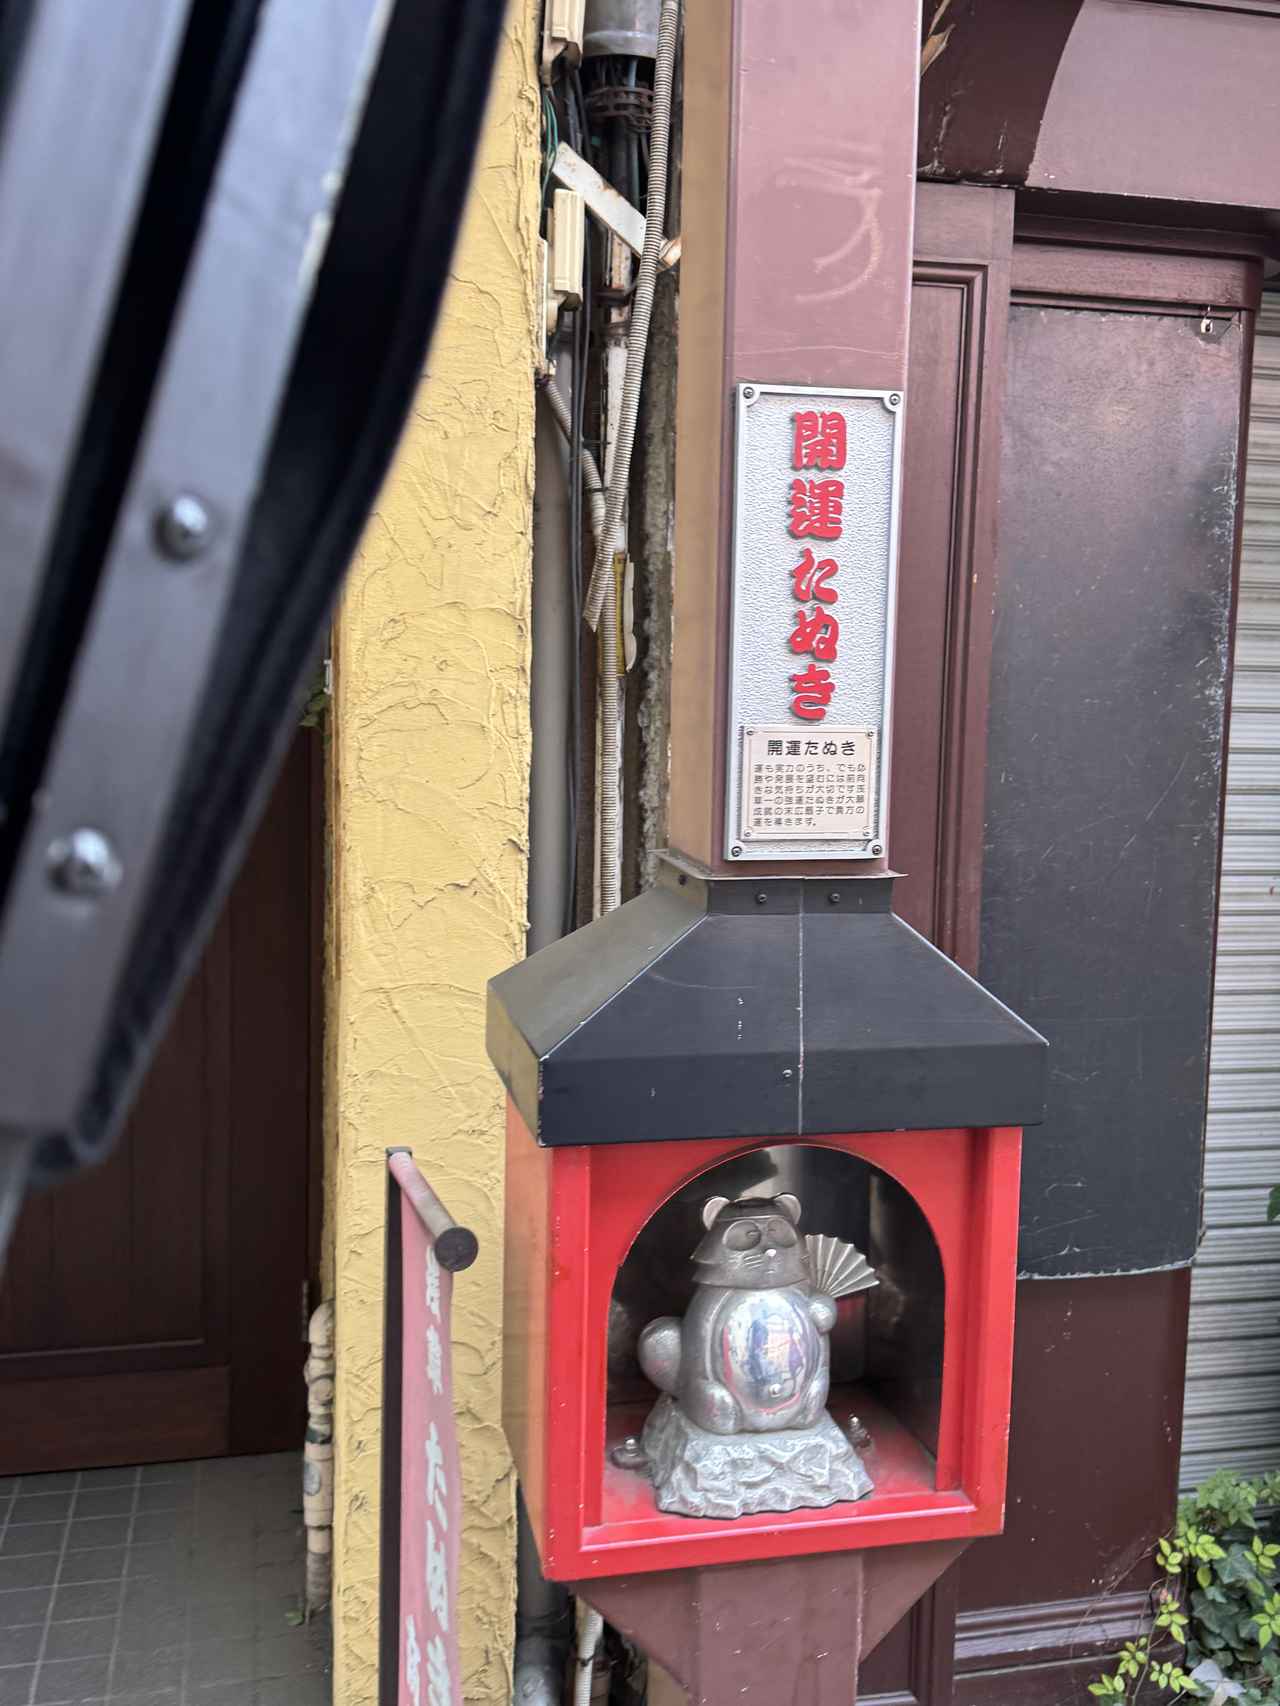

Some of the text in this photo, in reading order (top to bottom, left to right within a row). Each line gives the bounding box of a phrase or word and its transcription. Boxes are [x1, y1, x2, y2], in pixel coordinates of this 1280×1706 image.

[789, 410, 846, 720] 開運たぬき
[767, 740, 855, 756] 開運たぬき
